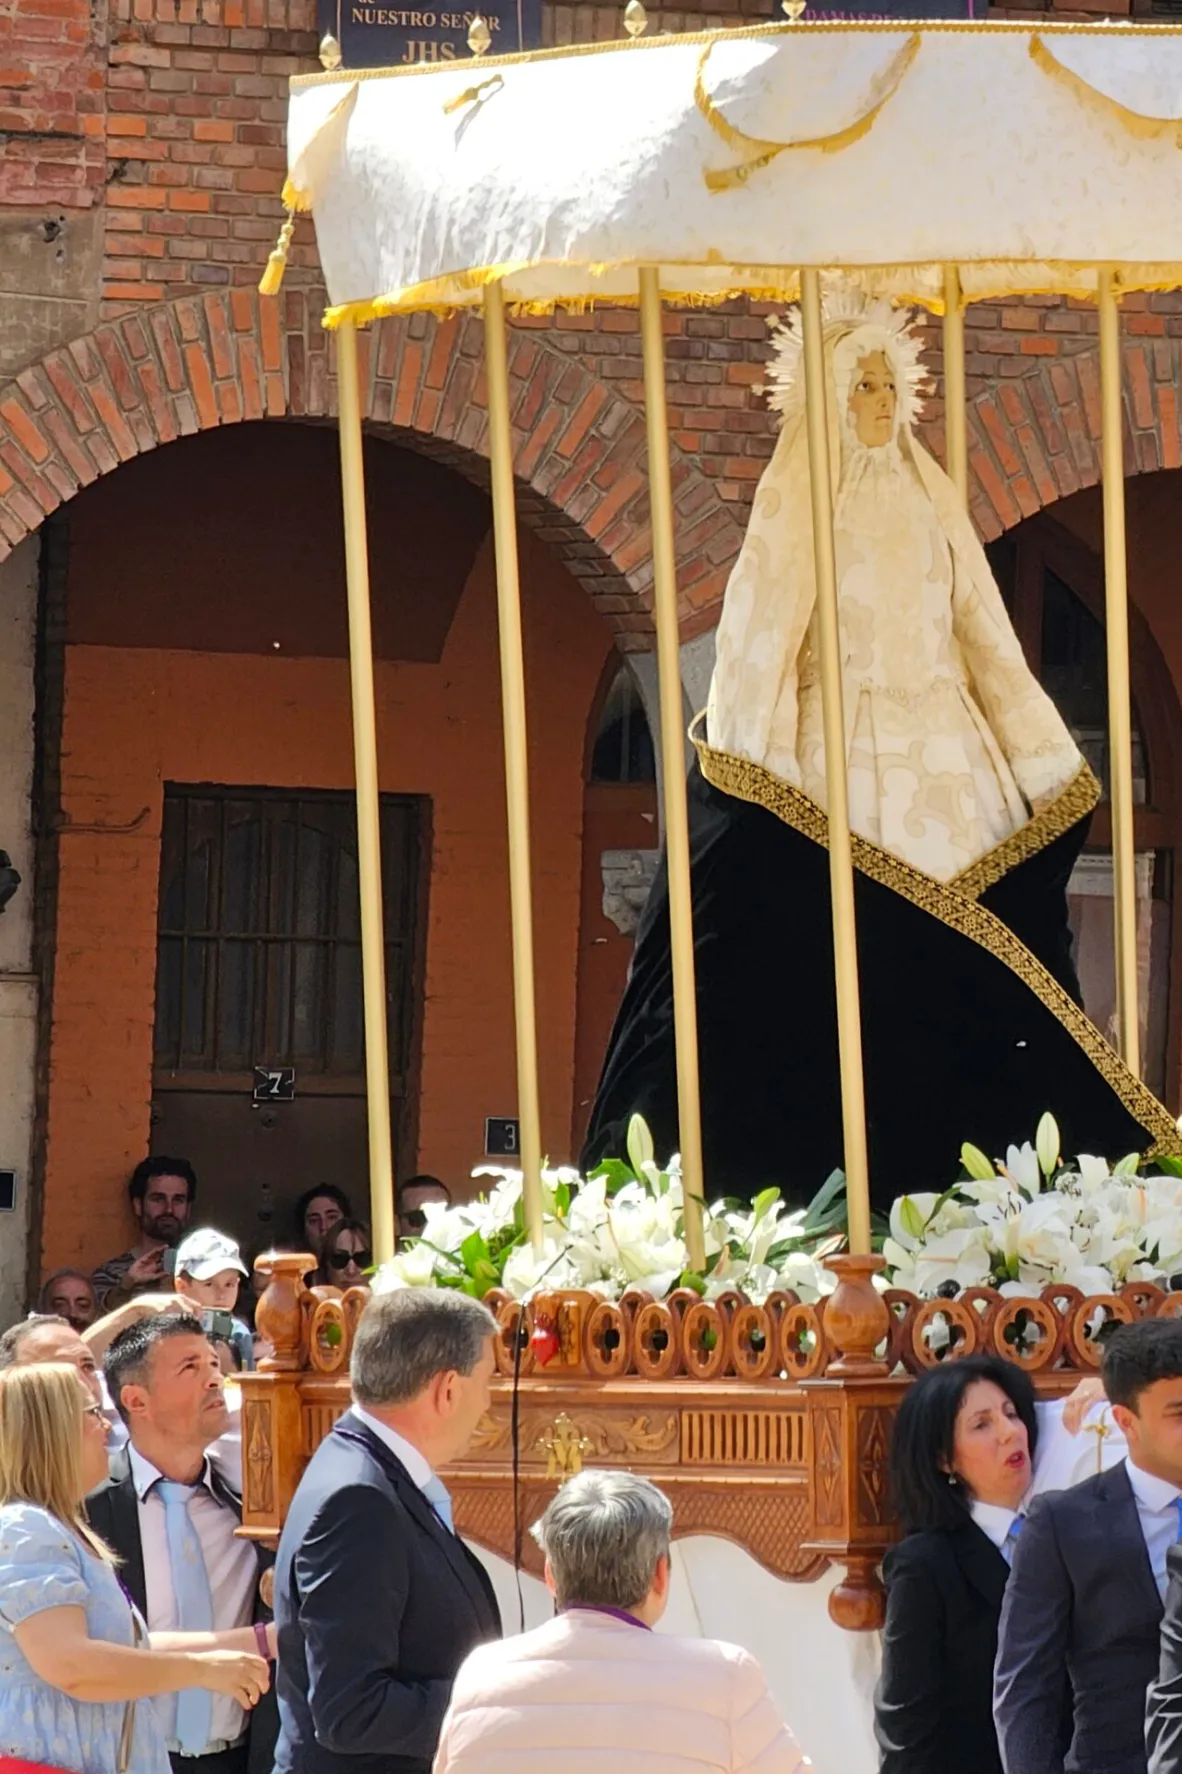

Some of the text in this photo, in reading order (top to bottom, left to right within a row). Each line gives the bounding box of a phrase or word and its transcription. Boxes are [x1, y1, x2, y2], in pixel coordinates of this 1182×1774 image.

[352, 8, 501, 31] NUESTRO SEÑR
[402, 41, 456, 62] JHS
[268, 1072, 283, 1094] 7
[504, 1124, 516, 1150] 3
